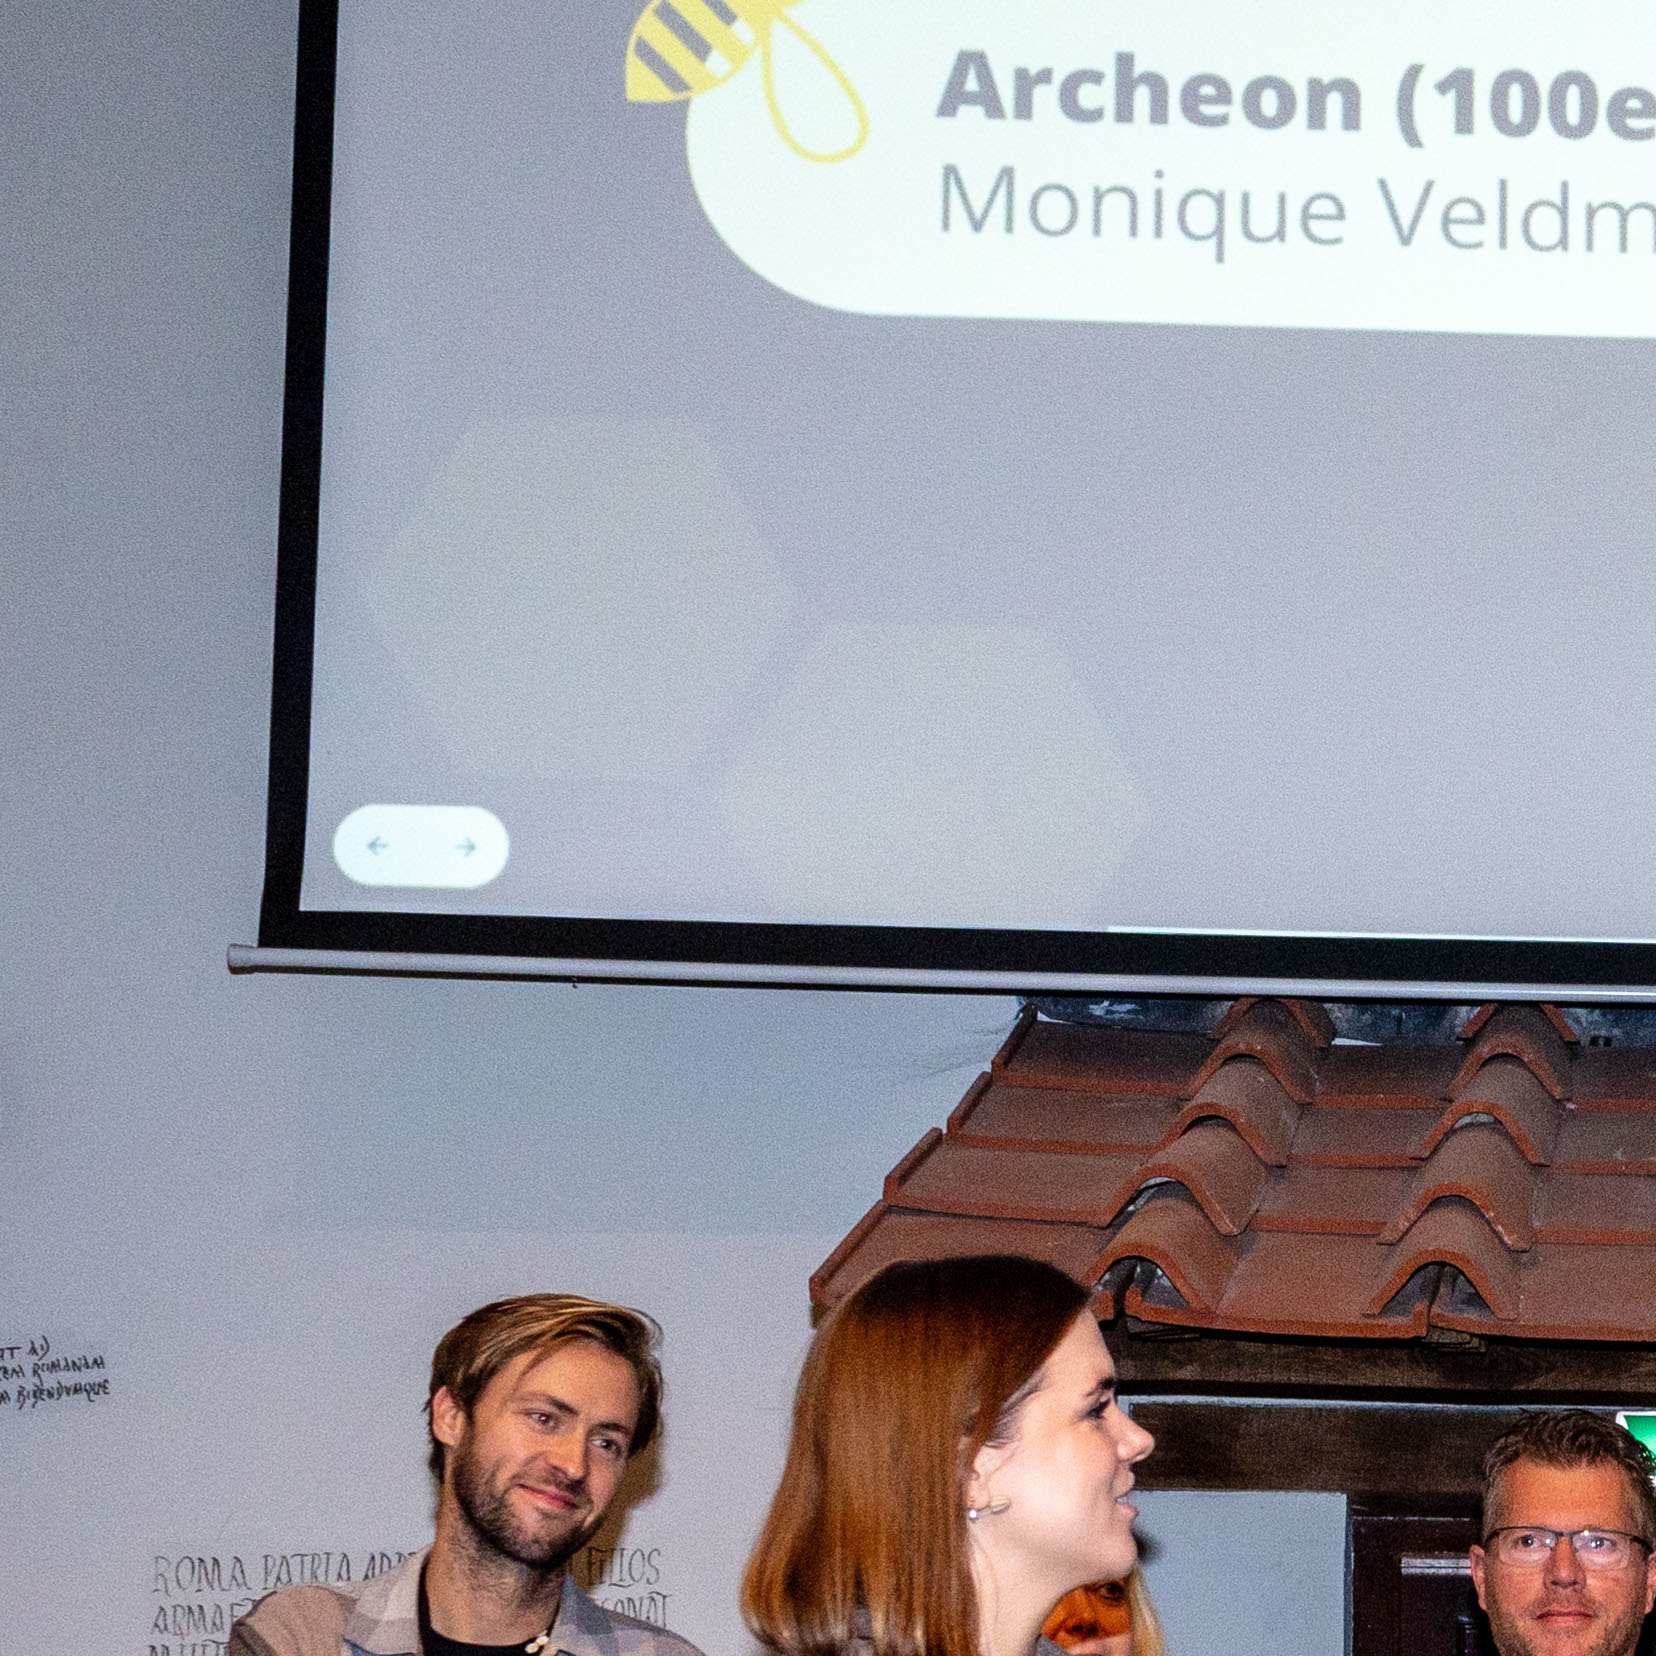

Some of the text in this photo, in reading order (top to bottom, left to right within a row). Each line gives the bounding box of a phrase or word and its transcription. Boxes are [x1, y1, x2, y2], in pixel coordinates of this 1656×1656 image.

[935, 49, 1362, 132] Archeon
[941, 162, 1347, 265] Monique
[152, 1555, 252, 1598] ROMA
[262, 1551, 352, 1591] PATRIA
